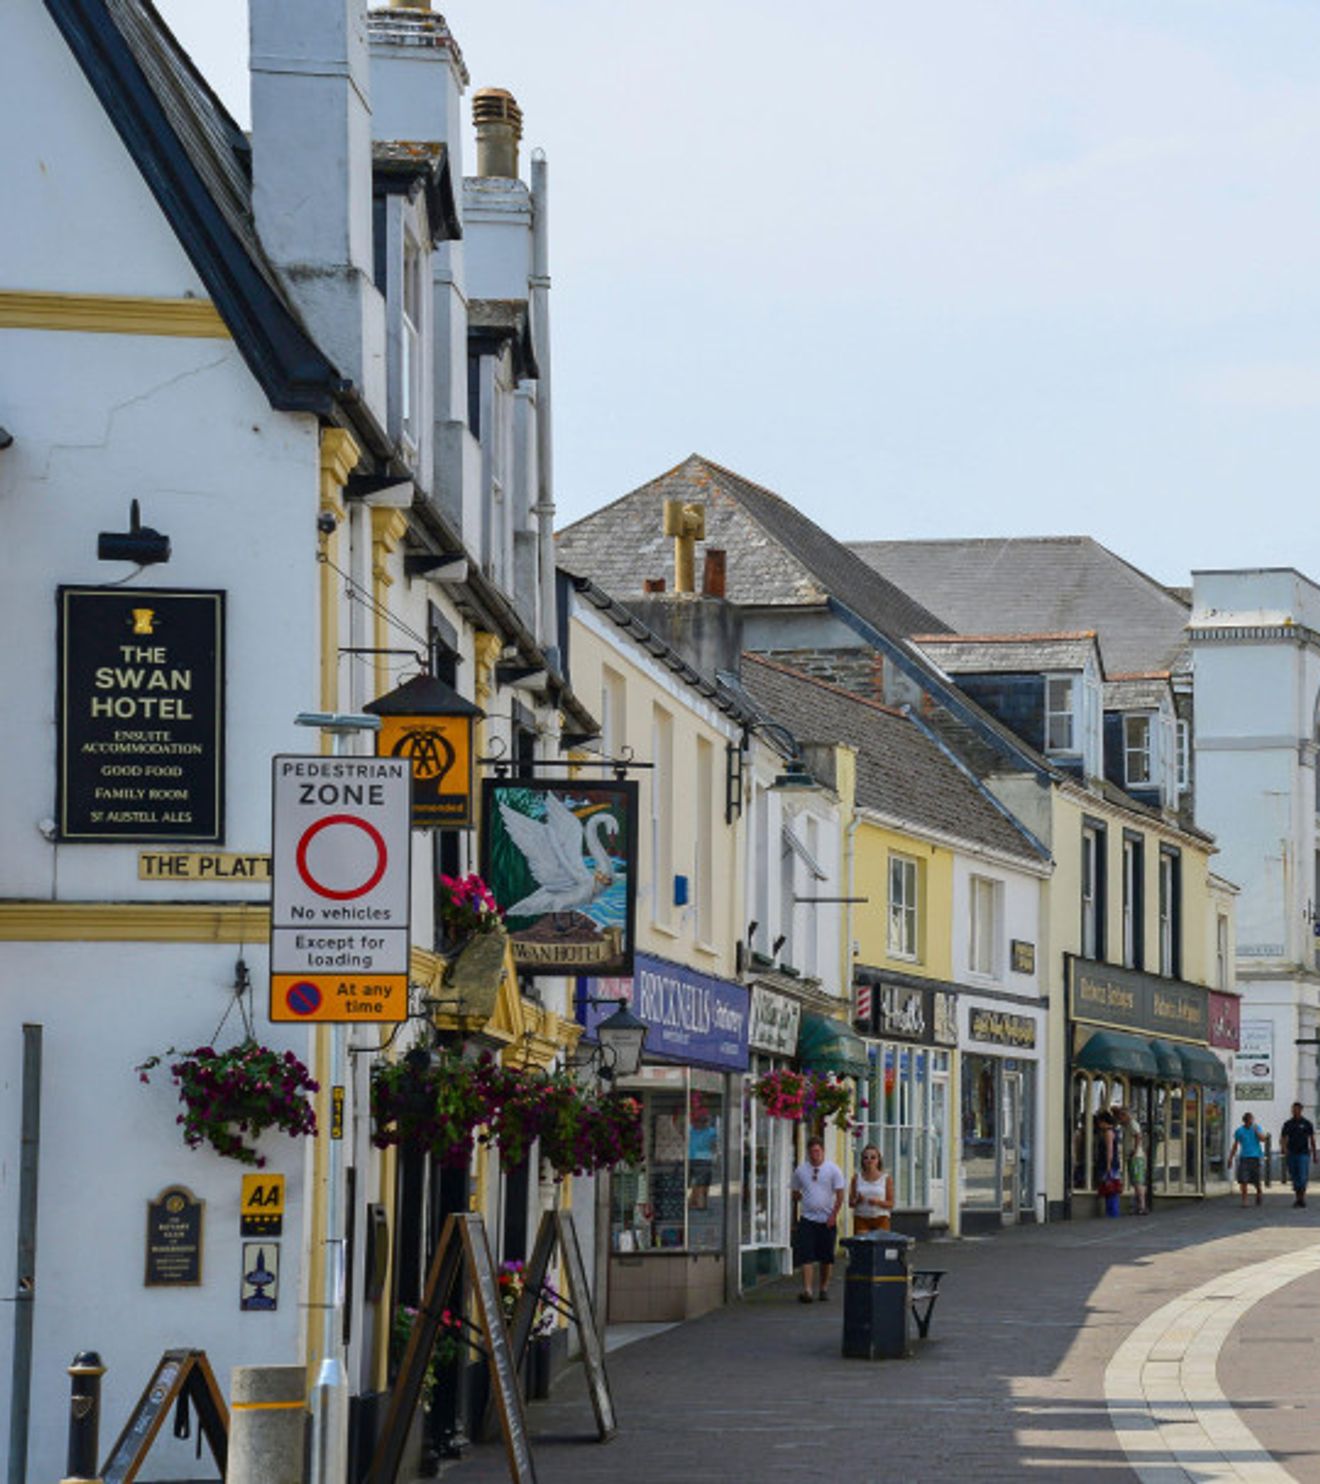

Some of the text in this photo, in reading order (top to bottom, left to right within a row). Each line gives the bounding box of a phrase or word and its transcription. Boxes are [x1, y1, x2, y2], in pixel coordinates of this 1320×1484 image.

[120, 645, 167, 664] THE
[95, 667, 191, 691] SWAN
[90, 696, 193, 719] HOTEL
[114, 730, 171, 742] ENSUITE
[81, 743, 202, 755] ACCOMMODATION
[101, 765, 182, 777] GOOD FOOD
[283, 763, 402, 778] PEDESTRIAN
[95, 787, 188, 800] FAMILY ROOM
[298, 784, 384, 805] ZONE
[107, 811, 158, 823] AUSTELL
[162, 811, 192, 823] ALES
[142, 856, 273, 877] THE PLATT
[291, 906, 391, 921] No vehicles
[295, 936, 385, 951] Except for
[514, 943, 550, 961] WAN
[308, 953, 373, 969] loading
[337, 982, 393, 999] At any
[345, 1001, 383, 1013] time
[248, 1185, 279, 1206] AA
